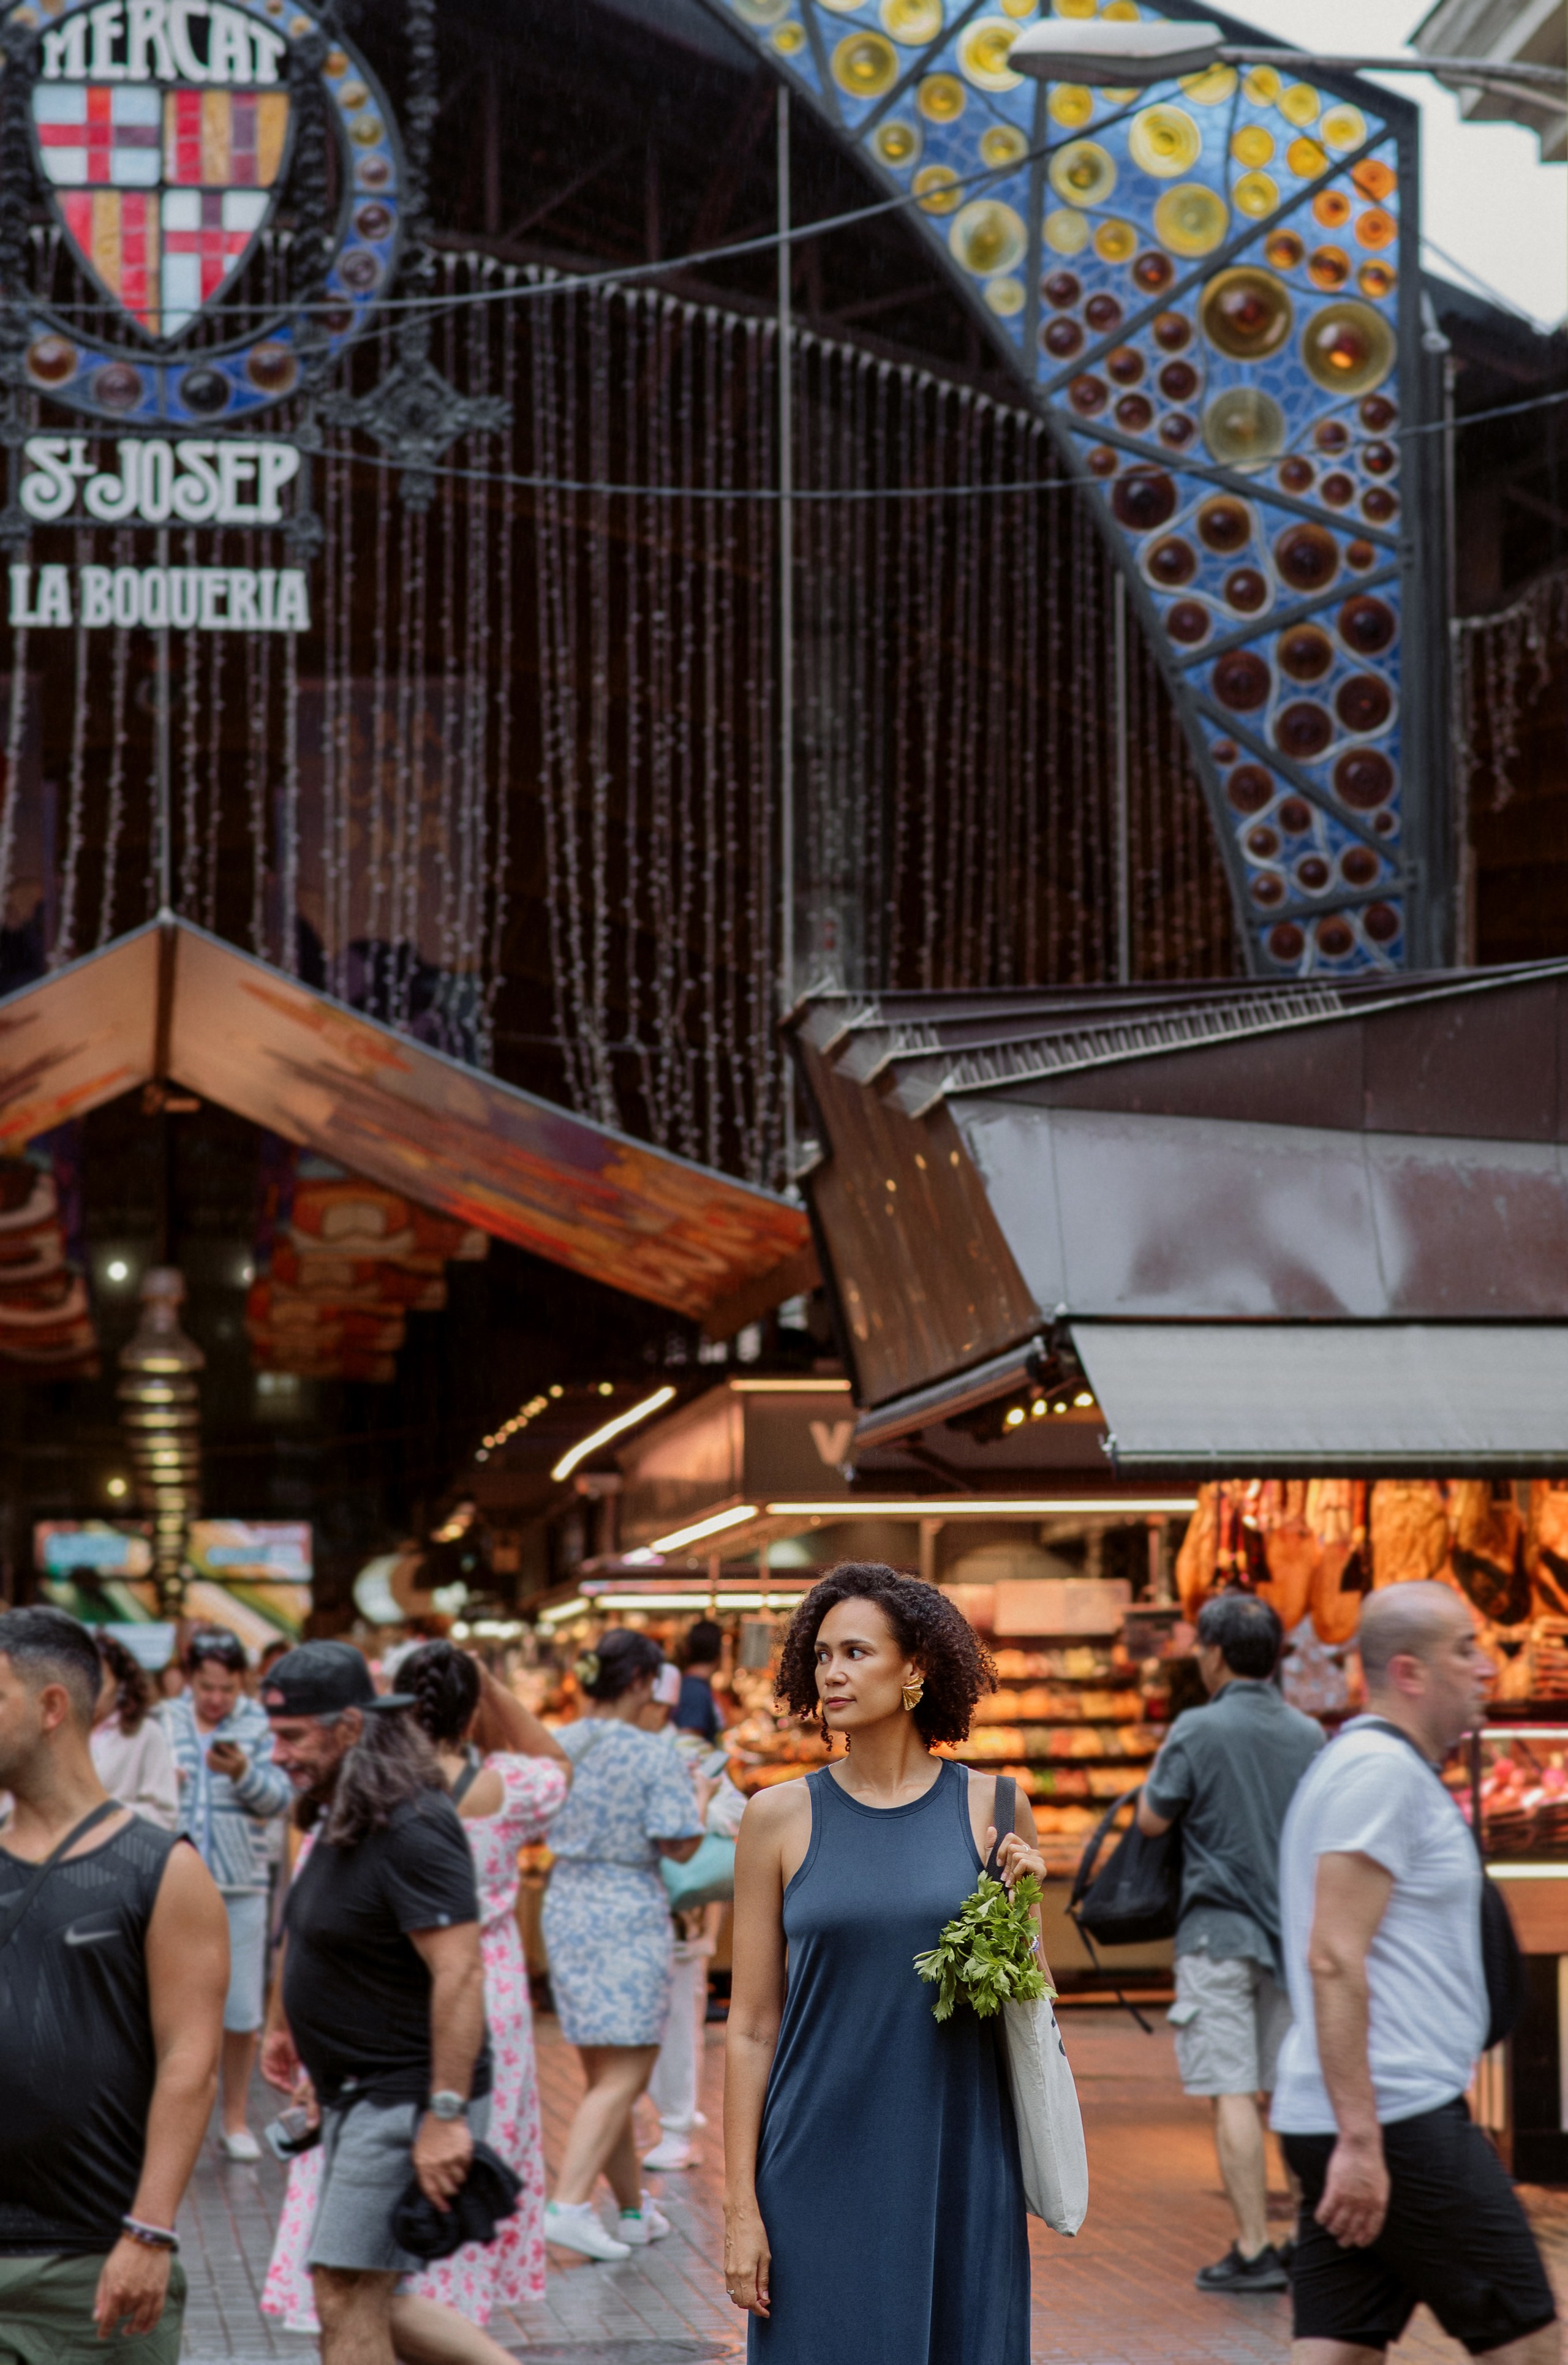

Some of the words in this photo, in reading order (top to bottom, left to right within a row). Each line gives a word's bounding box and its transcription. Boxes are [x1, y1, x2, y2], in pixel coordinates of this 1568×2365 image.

[42, 0, 285, 83] MERCAT
[83, 439, 300, 523] JOSEP
[9, 564, 72, 628] LA
[80, 566, 310, 631] BOQUERIA
